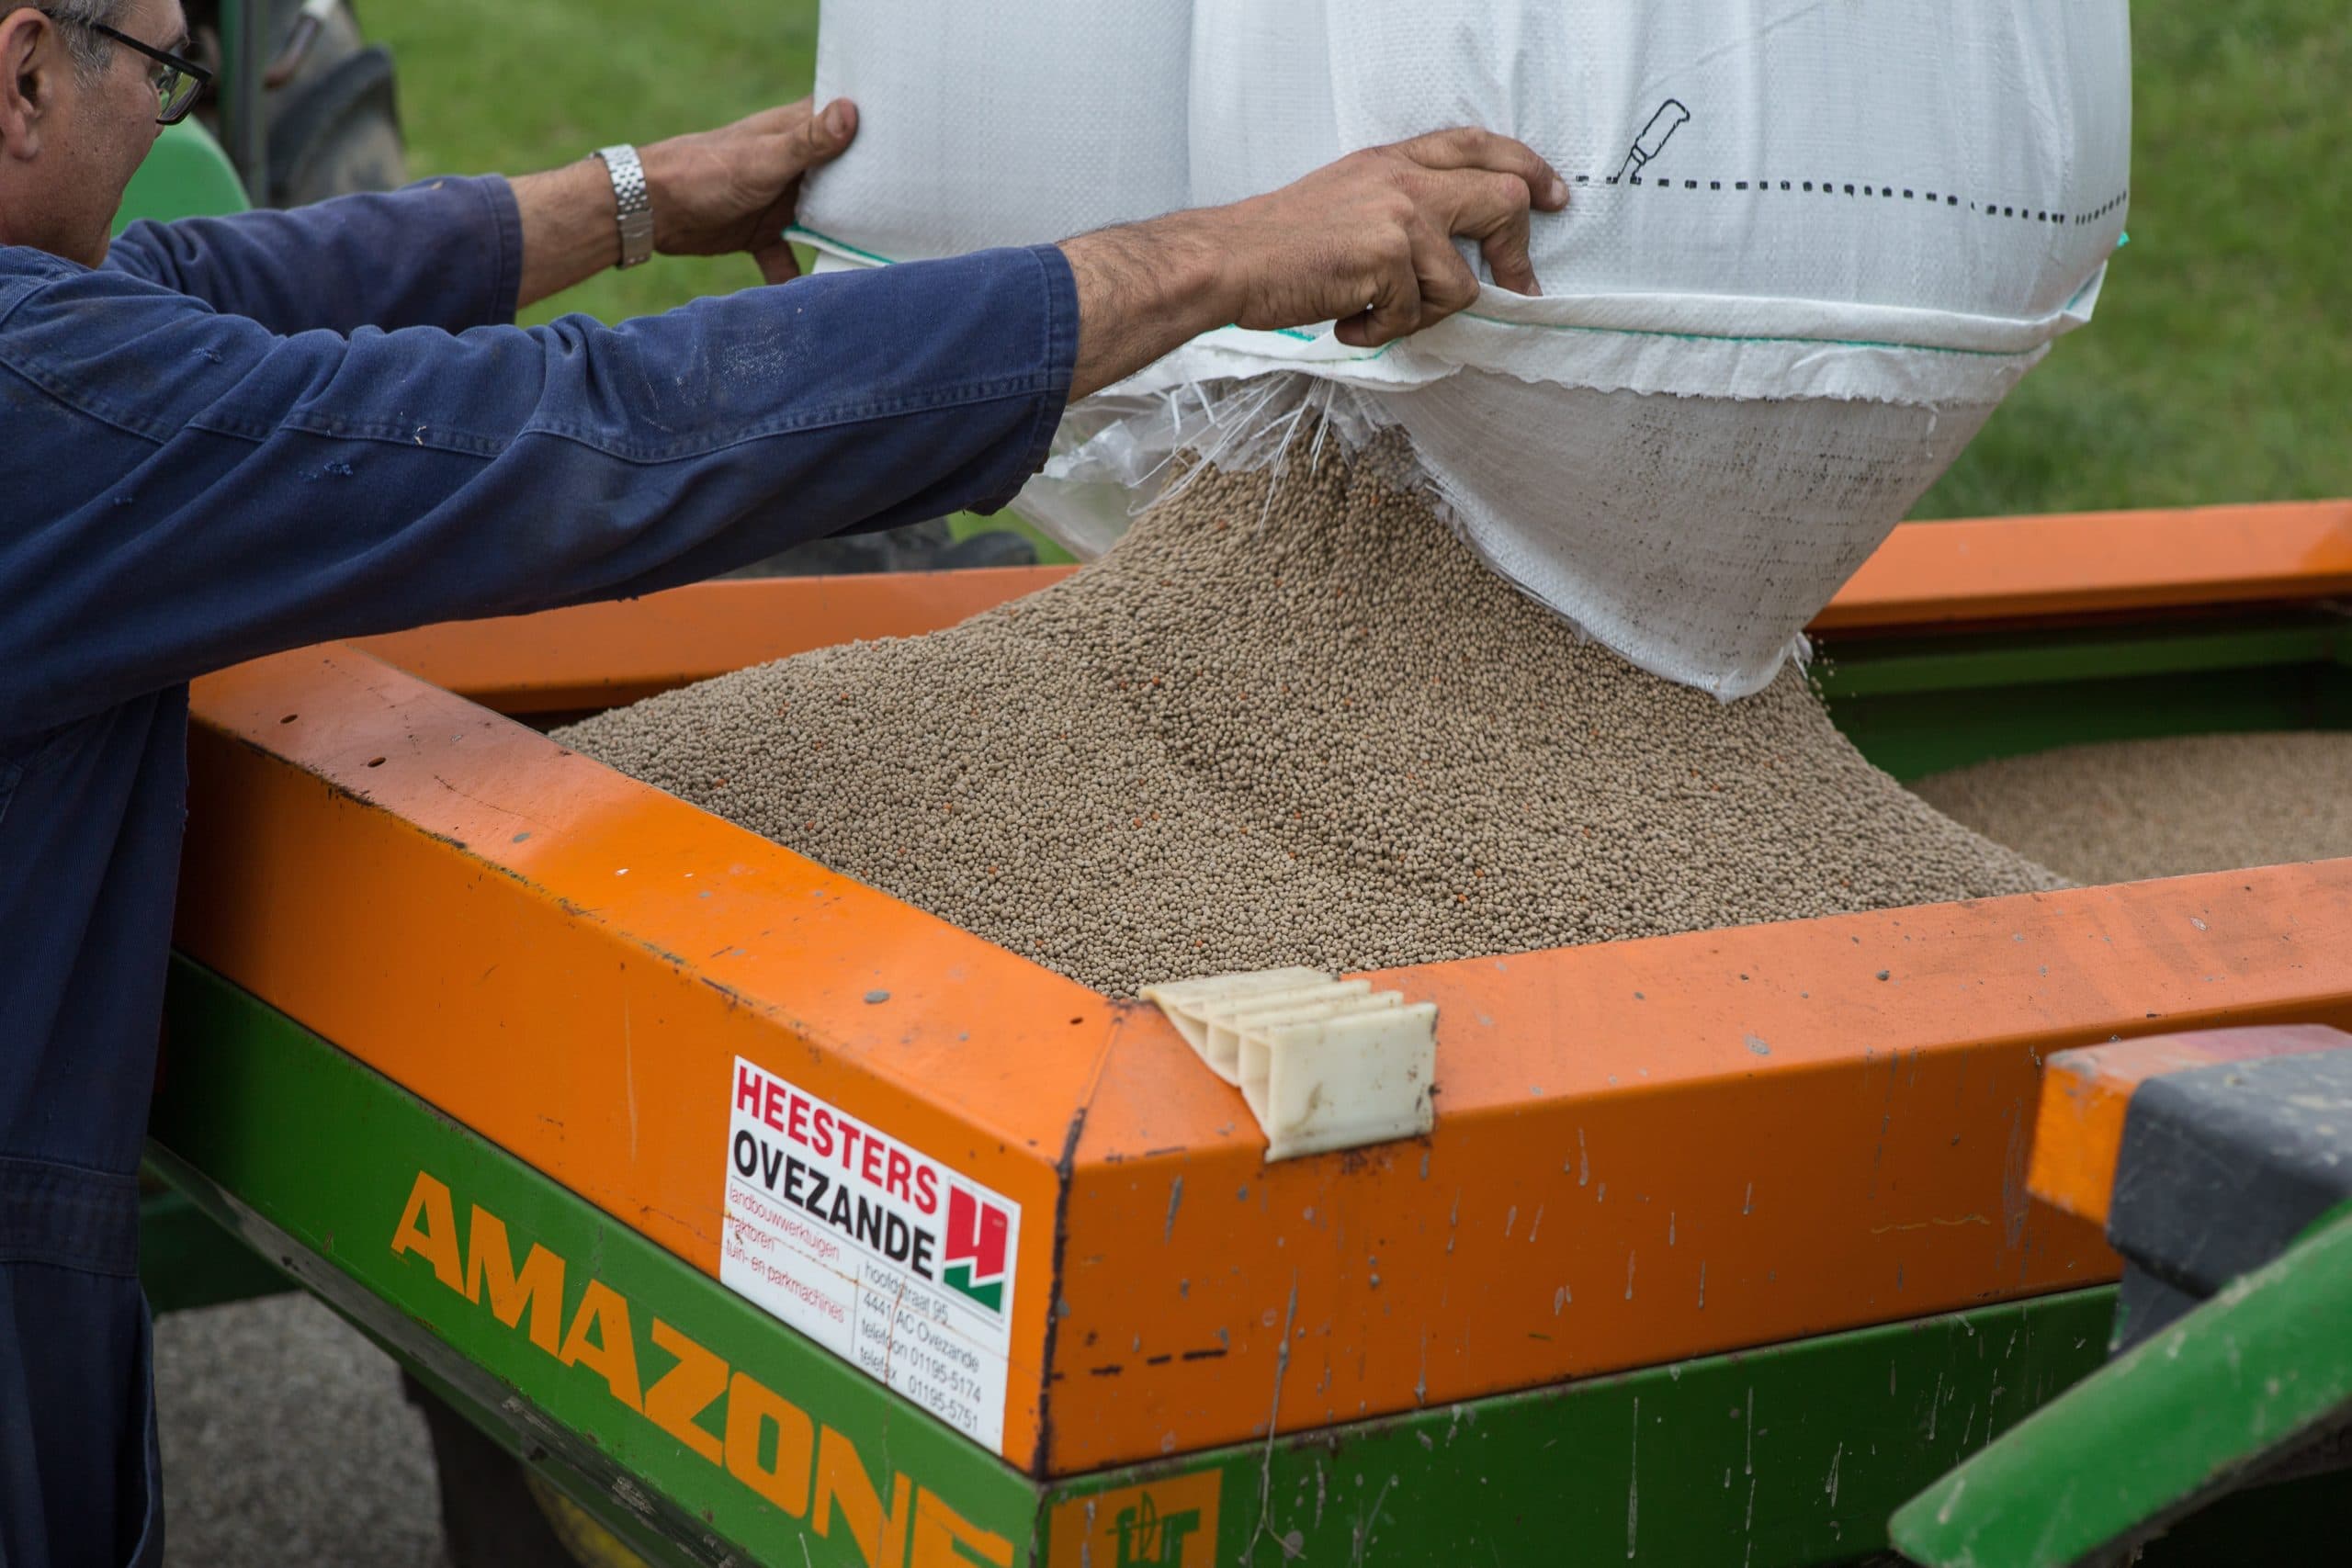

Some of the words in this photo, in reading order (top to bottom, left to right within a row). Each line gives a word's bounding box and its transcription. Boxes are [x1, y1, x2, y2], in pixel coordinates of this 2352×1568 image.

[737, 1066, 938, 1215] HEESTERS
[728, 1214, 775, 1253] traktoren
[729, 1183, 840, 1262] landbouwwerktuigen
[734, 1129, 934, 1281] OVEZANDE
[727, 1239, 748, 1262] tuin-
[751, 1256, 765, 1276] en
[766, 1265, 844, 1324] parkmachines
[933, 1300, 949, 1325] 95
[863, 1292, 892, 1321] 4441
[895, 1309, 915, 1335] AC
[918, 1320, 980, 1374] Ovezande
[909, 1374, 978, 1431] 01195-5751
[910, 1347, 980, 1404] 01195-5174
